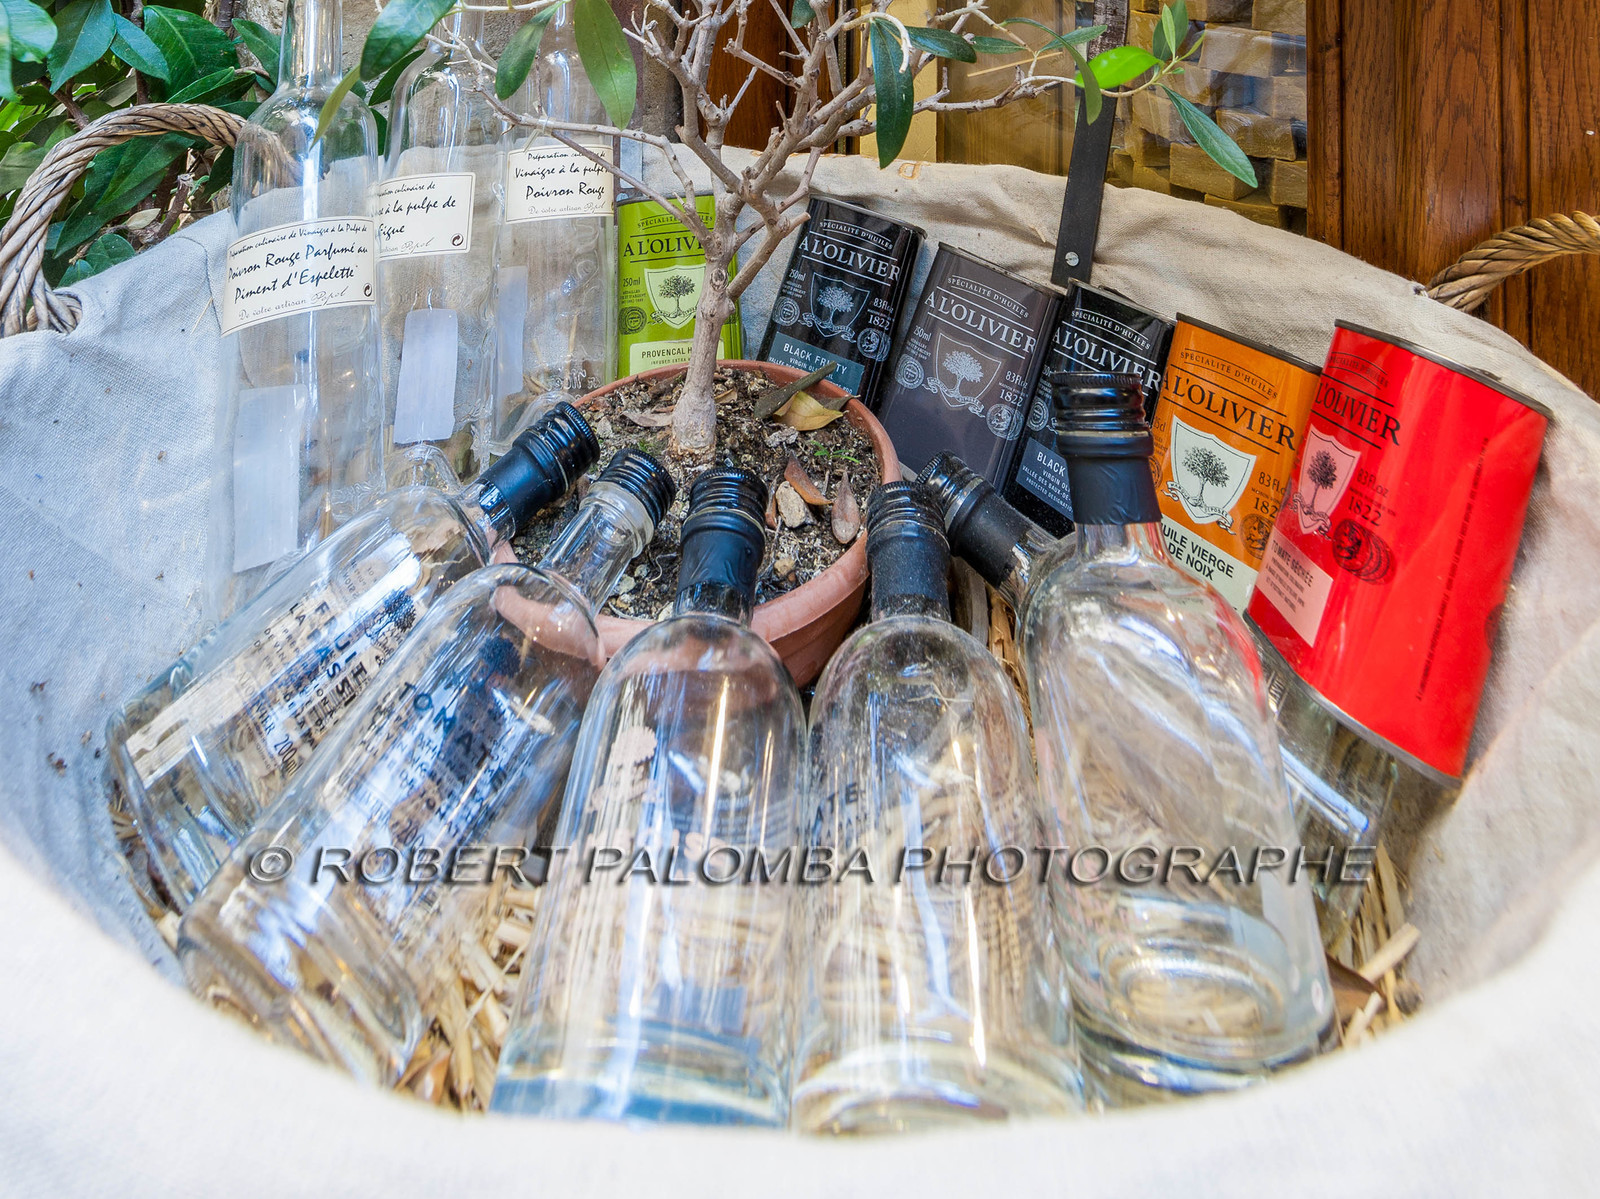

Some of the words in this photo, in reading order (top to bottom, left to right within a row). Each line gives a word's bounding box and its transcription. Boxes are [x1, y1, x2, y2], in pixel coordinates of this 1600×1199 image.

[515, 164, 556, 180] Vinaigre
[559, 164, 565, 174] à
[569, 164, 579, 174] la
[526, 185, 575, 200] Poivron
[579, 182, 606, 197] Rouge
[392, 200, 403, 213] la
[407, 200, 438, 216] pulpe
[443, 197, 456, 208] de
[820, 220, 861, 236] SPÉCIALITÉ
[861, 230, 893, 249] D'HUILES
[266, 253, 300, 267] Rouge
[306, 243, 354, 260] Parfumé
[624, 243, 634, 257] A
[799, 235, 810, 250] A
[813, 240, 900, 281] L'OLIVIER
[235, 279, 277, 303] Piment
[282, 265, 354, 289] d'Espelette
[948, 277, 991, 297] SPÉCIALITÉ
[993, 294, 1029, 318] D'HUILES
[868, 315, 890, 330] 1822
[925, 292, 936, 306] A
[938, 298, 1036, 354] L'OLIVIER
[1053, 327, 1061, 343] A
[1072, 310, 1114, 328] SPÉCIALITÉ
[1114, 324, 1150, 350] D'HUILES
[642, 348, 685, 358] PROVENCAL
[783, 343, 811, 361] BLACK
[789, 357, 807, 368] VIRGIN
[1181, 352, 1232, 373] SPÉCIALITÉ
[1234, 369, 1278, 399] D'HUILES
[999, 389, 1024, 406] 1822
[1170, 378, 1296, 451] L'OLIVIER
[1315, 381, 1401, 447] L'OLIVIER
[1037, 452, 1066, 477] BLACK
[1043, 469, 1061, 484] VIRGIN
[1025, 477, 1047, 494] PROTECTED
[1348, 496, 1382, 526] 1822
[1168, 542, 1184, 560] DE
[1185, 554, 1215, 581] NOIX
[1191, 540, 1236, 578] VIERGE
[1271, 540, 1291, 566] TOMATE
[1291, 559, 1313, 587] SÉCHÉE
